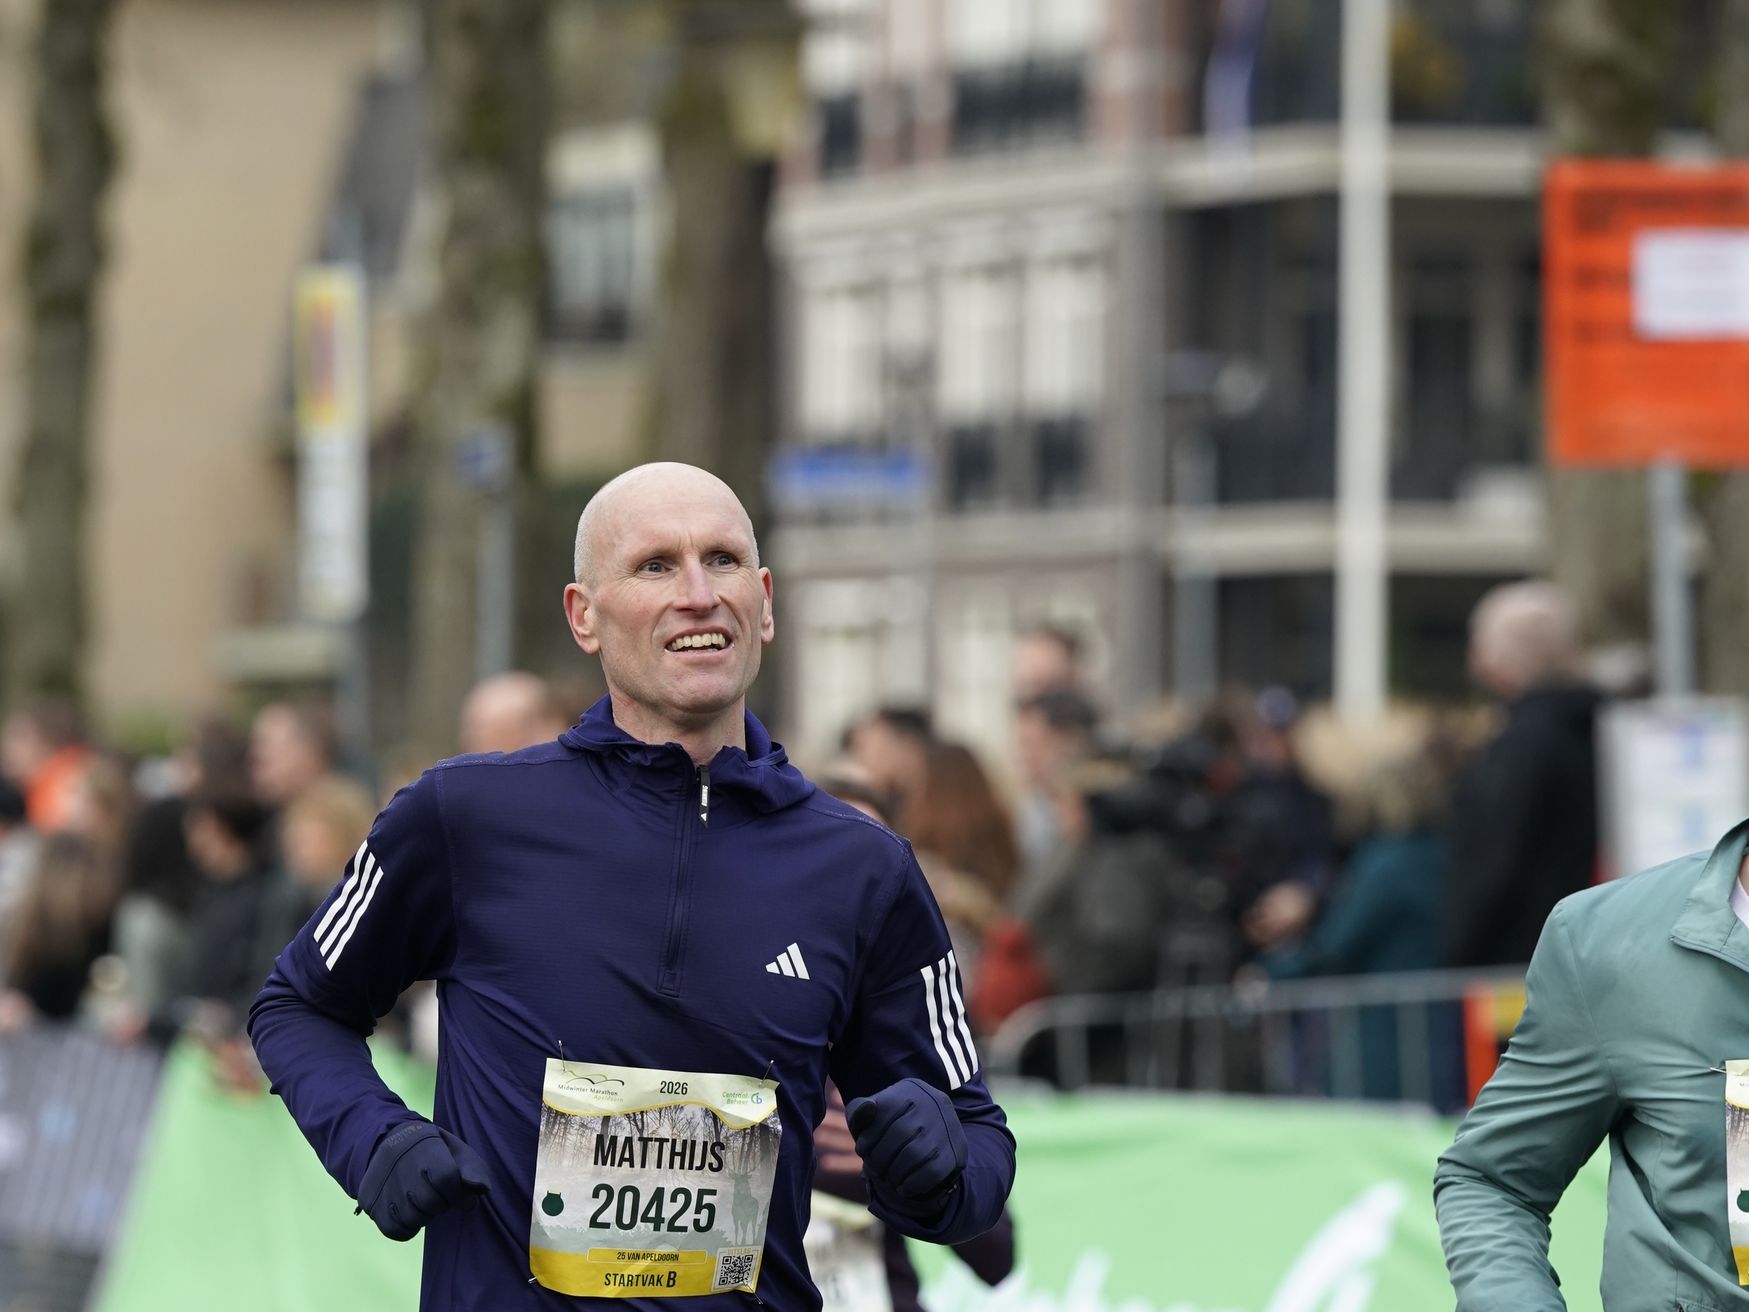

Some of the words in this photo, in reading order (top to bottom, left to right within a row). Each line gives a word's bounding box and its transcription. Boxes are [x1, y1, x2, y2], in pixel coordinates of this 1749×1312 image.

[558, 1084, 588, 1092] Midwinter
[590, 1087, 618, 1096] Marathon
[660, 1080, 688, 1095] 2026
[593, 1134, 725, 1172] MATTHIJS
[589, 1183, 717, 1233] 20425
[617, 1251, 626, 1260] 25
[628, 1252, 640, 1261] VAN
[641, 1252, 679, 1262] APELDOORN
[604, 1272, 663, 1287] STARTVAK
[666, 1271, 677, 1288] B
